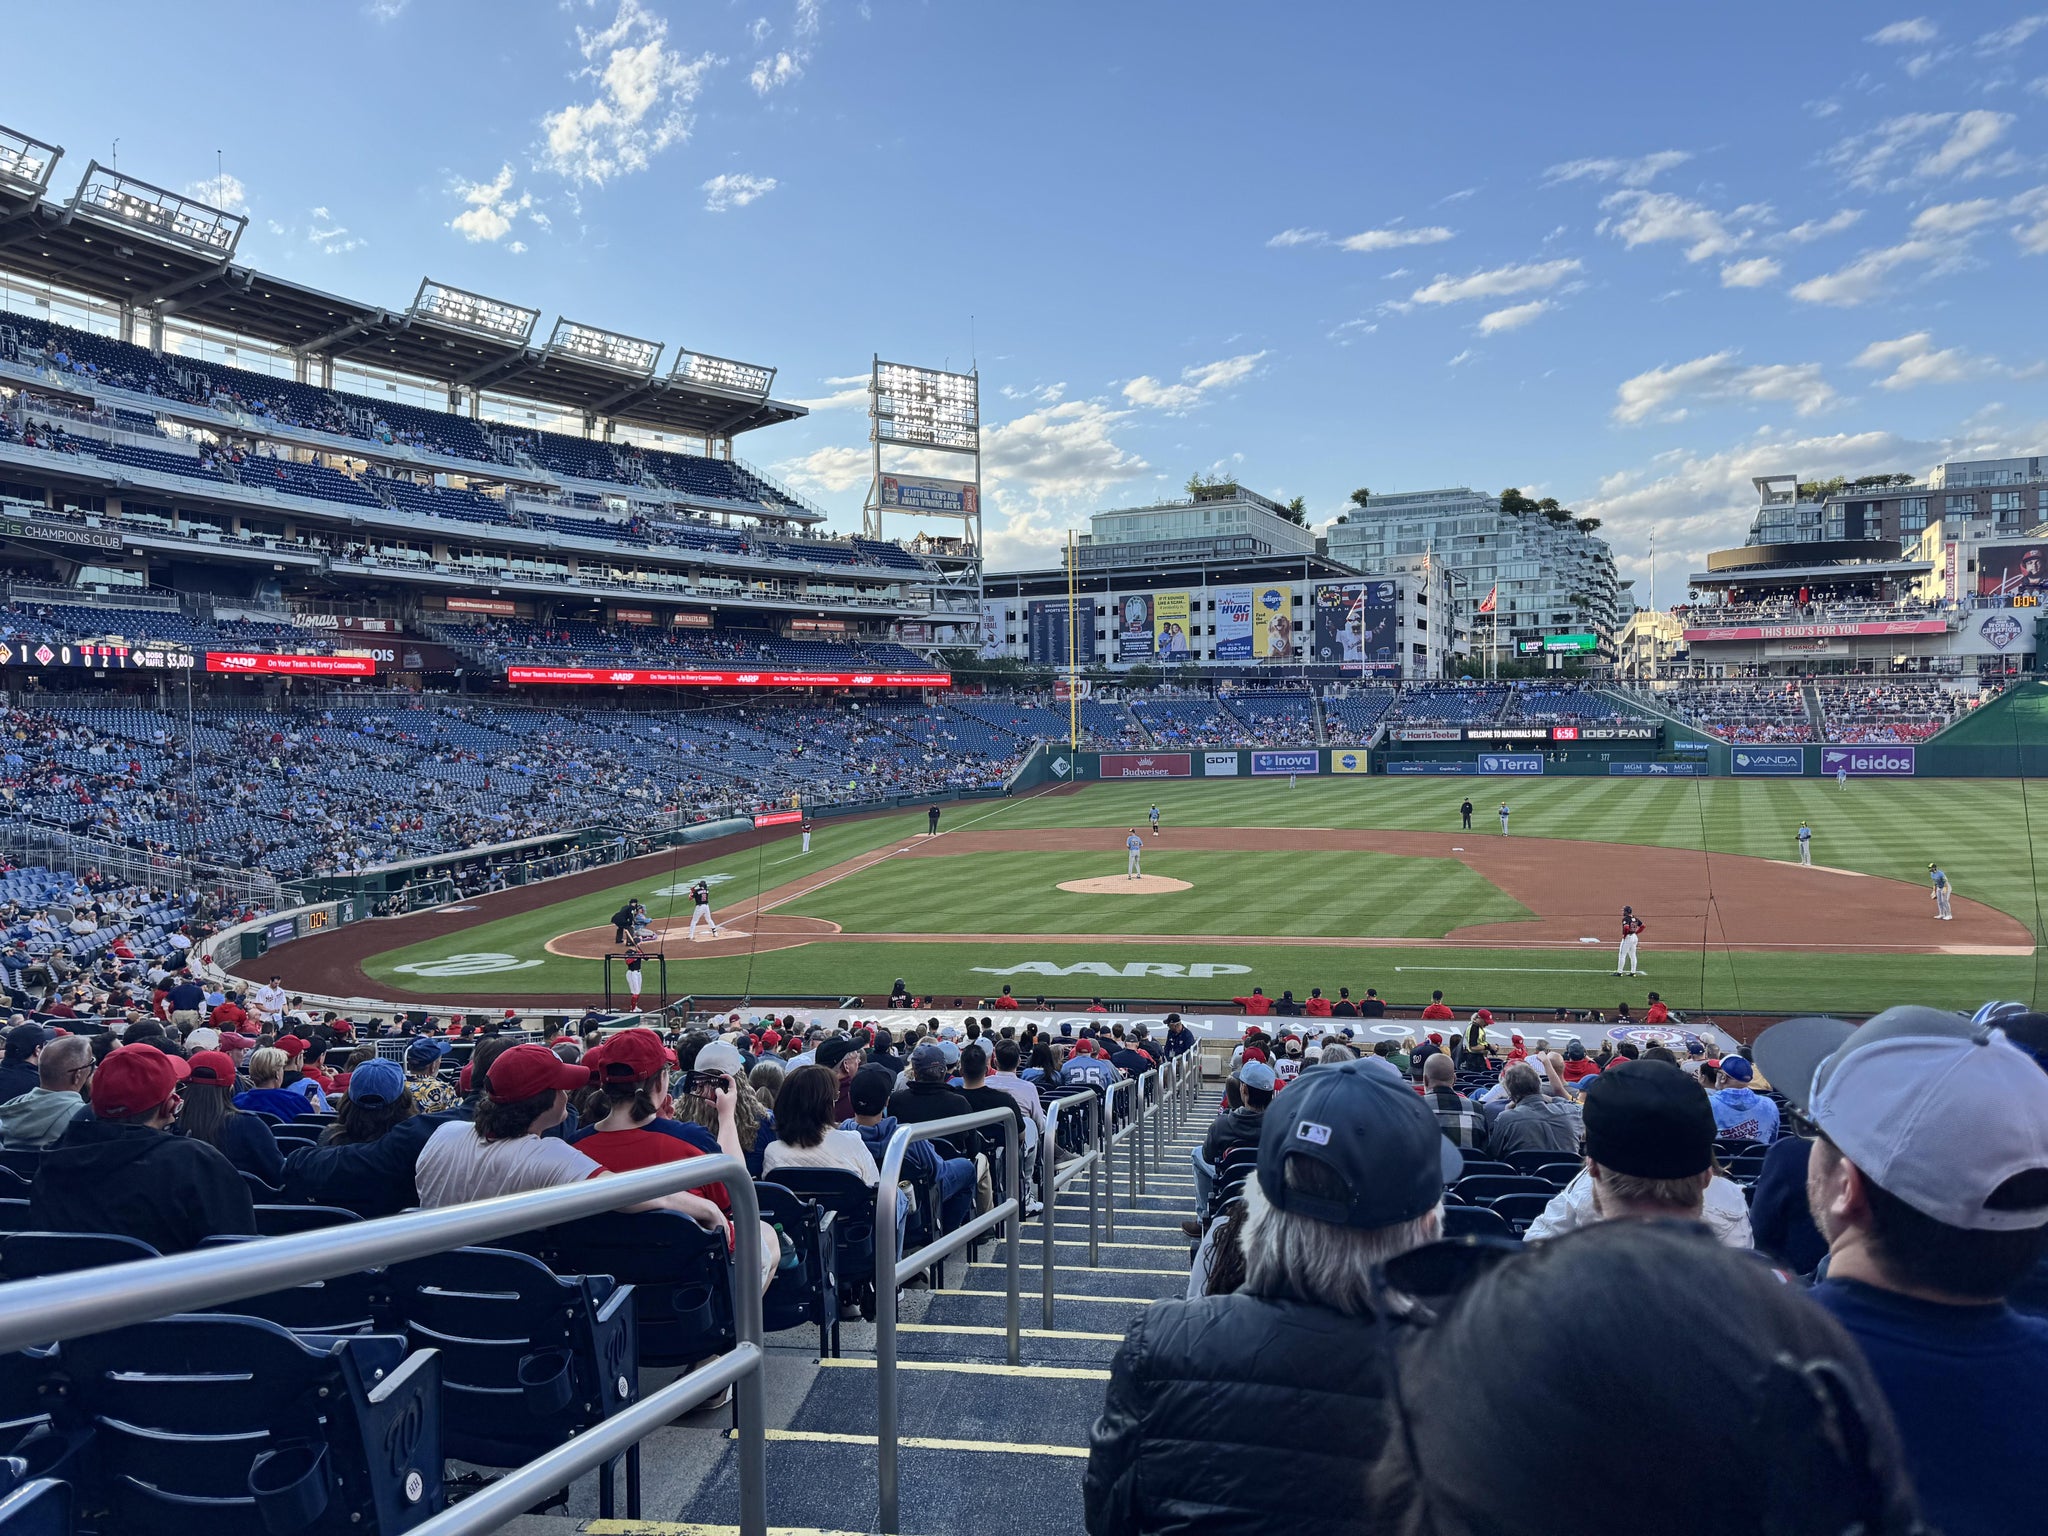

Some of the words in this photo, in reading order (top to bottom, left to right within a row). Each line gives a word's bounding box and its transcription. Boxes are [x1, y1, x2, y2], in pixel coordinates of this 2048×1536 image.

[903, 488, 931, 500] BEAUTIFUL
[931, 491, 947, 501] VIEWS
[947, 493, 958, 501] AND
[901, 496, 920, 506] AWARD
[921, 498, 943, 508] WINNING
[943, 501, 961, 510] BREWS
[24, 525, 90, 544] CHAMPIONS
[92, 534, 120, 548] CLUB
[1946, 554, 1954, 577] TEAM
[1946, 577, 1954, 600] STORE
[1811, 592, 1838, 600] LOFT
[2013, 596, 2037, 608] 0:04
[1222, 604, 1250, 614] HVAC
[1233, 613, 1249, 622] 911
[1759, 627, 1783, 637] THIS
[1784, 625, 1815, 636] BUD'S
[1816, 625, 1836, 635] FOR
[1838, 624, 1862, 635] YOU.
[1982, 626, 2021, 634] CHAMPIONS
[21, 644, 28, 663] 1
[61, 646, 71, 665] 0
[85, 655, 92, 667] 0
[102, 656, 109, 668] 2
[119, 656, 125, 668] 1
[145, 659, 164, 667] RAFFLE
[268, 659, 277, 667] On
[277, 660, 291, 668] Your
[317, 661, 333, 670] Every
[334, 662, 366, 670] Community.
[610, 672, 634, 681] AARP
[736, 674, 759, 683] AARP
[1407, 731, 1432, 739] Harris
[1432, 731, 1459, 739] Teeter
[1467, 730, 1493, 739] WELCOME
[1493, 730, 1501, 738] TO
[1501, 730, 1531, 738] NATIONALS
[1532, 729, 1547, 738] PARK
[1556, 729, 1574, 738] 6:56
[1618, 729, 1652, 738] FAN
[1206, 756, 1236, 764] GDIT
[1275, 754, 1311, 766] Inova
[1500, 759, 1537, 770] Terra
[1750, 756, 1798, 764] VANDA
[1850, 754, 1911, 770] leidos
[968, 961, 1253, 978] AARP
[1070, 1067, 1100, 1085] 26
[1720, 1119, 1759, 1136] GRATEFUL
[408, 1477, 420, 1495] HH
